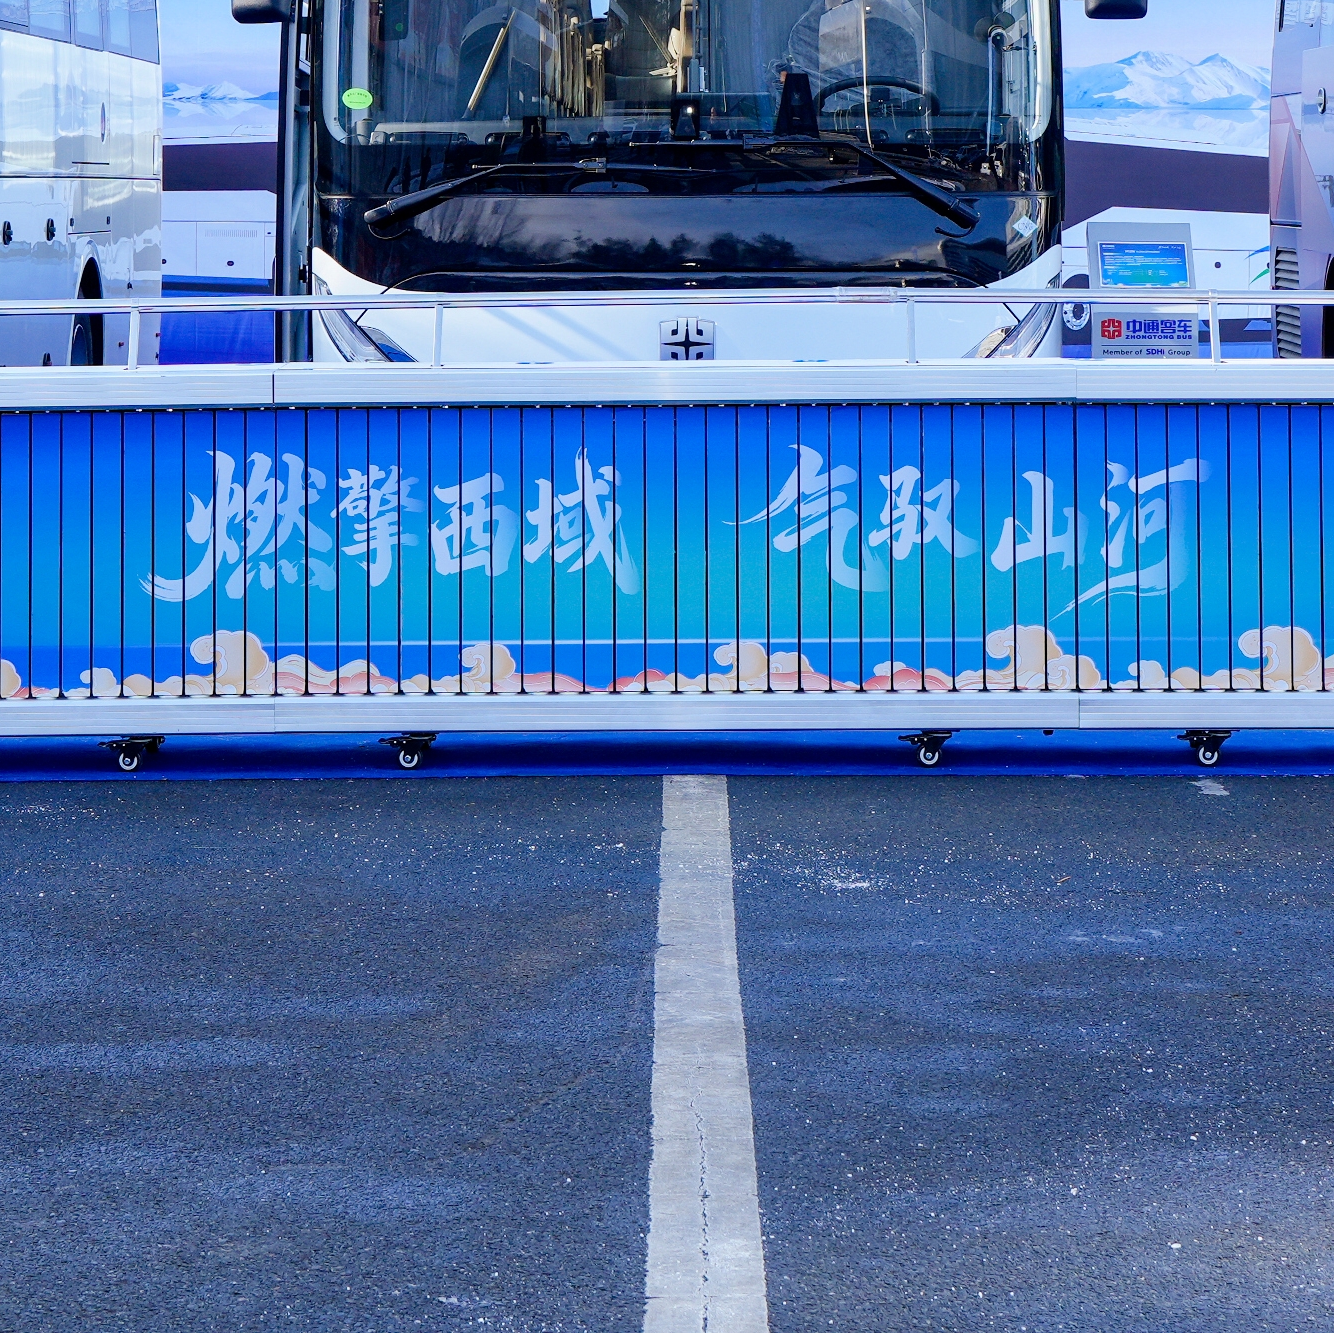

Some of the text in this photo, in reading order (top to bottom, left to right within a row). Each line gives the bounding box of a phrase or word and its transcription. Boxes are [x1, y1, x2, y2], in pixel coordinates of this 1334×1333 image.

[1126, 319, 1192, 334] 中通客车
[137, 444, 1211, 623] 燃擎西域 气驭山河
